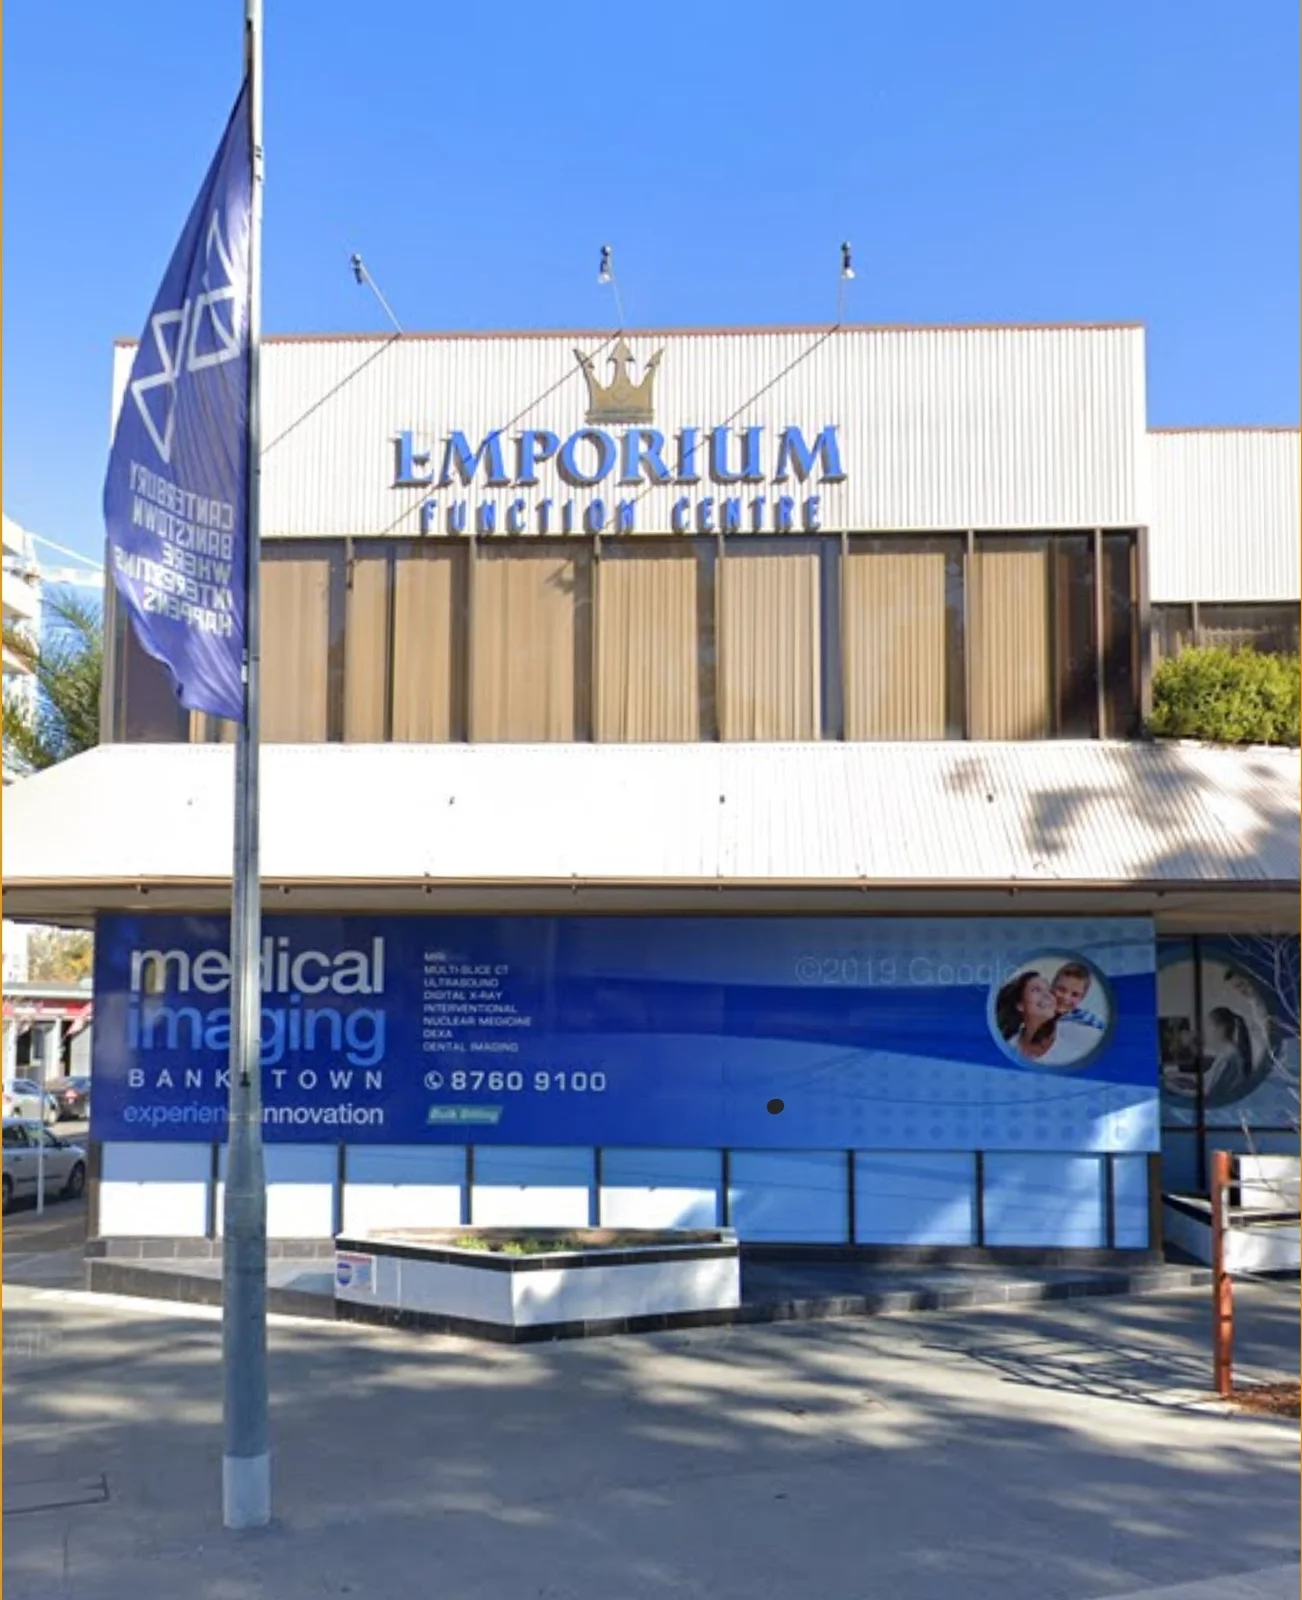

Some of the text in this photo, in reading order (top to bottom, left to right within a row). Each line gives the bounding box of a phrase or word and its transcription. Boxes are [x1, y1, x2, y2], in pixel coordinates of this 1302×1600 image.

[389, 424, 847, 489] EMPORIUM
[420, 494, 824, 536] FUNCTION CENTRE
[424, 978, 499, 988] ULTRASOUND
[424, 990, 503, 1000] DIGITAL X-RAY
[423, 1003, 518, 1013] INTERVENTIONAL
[423, 1016, 476, 1026] NUCLEAR
[422, 1042, 466, 1052] DENTAL
[128, 1069, 383, 1089] BANKTOWN
[450, 1071, 607, 1091] 8760 9100
[123, 1101, 230, 1128] experien
